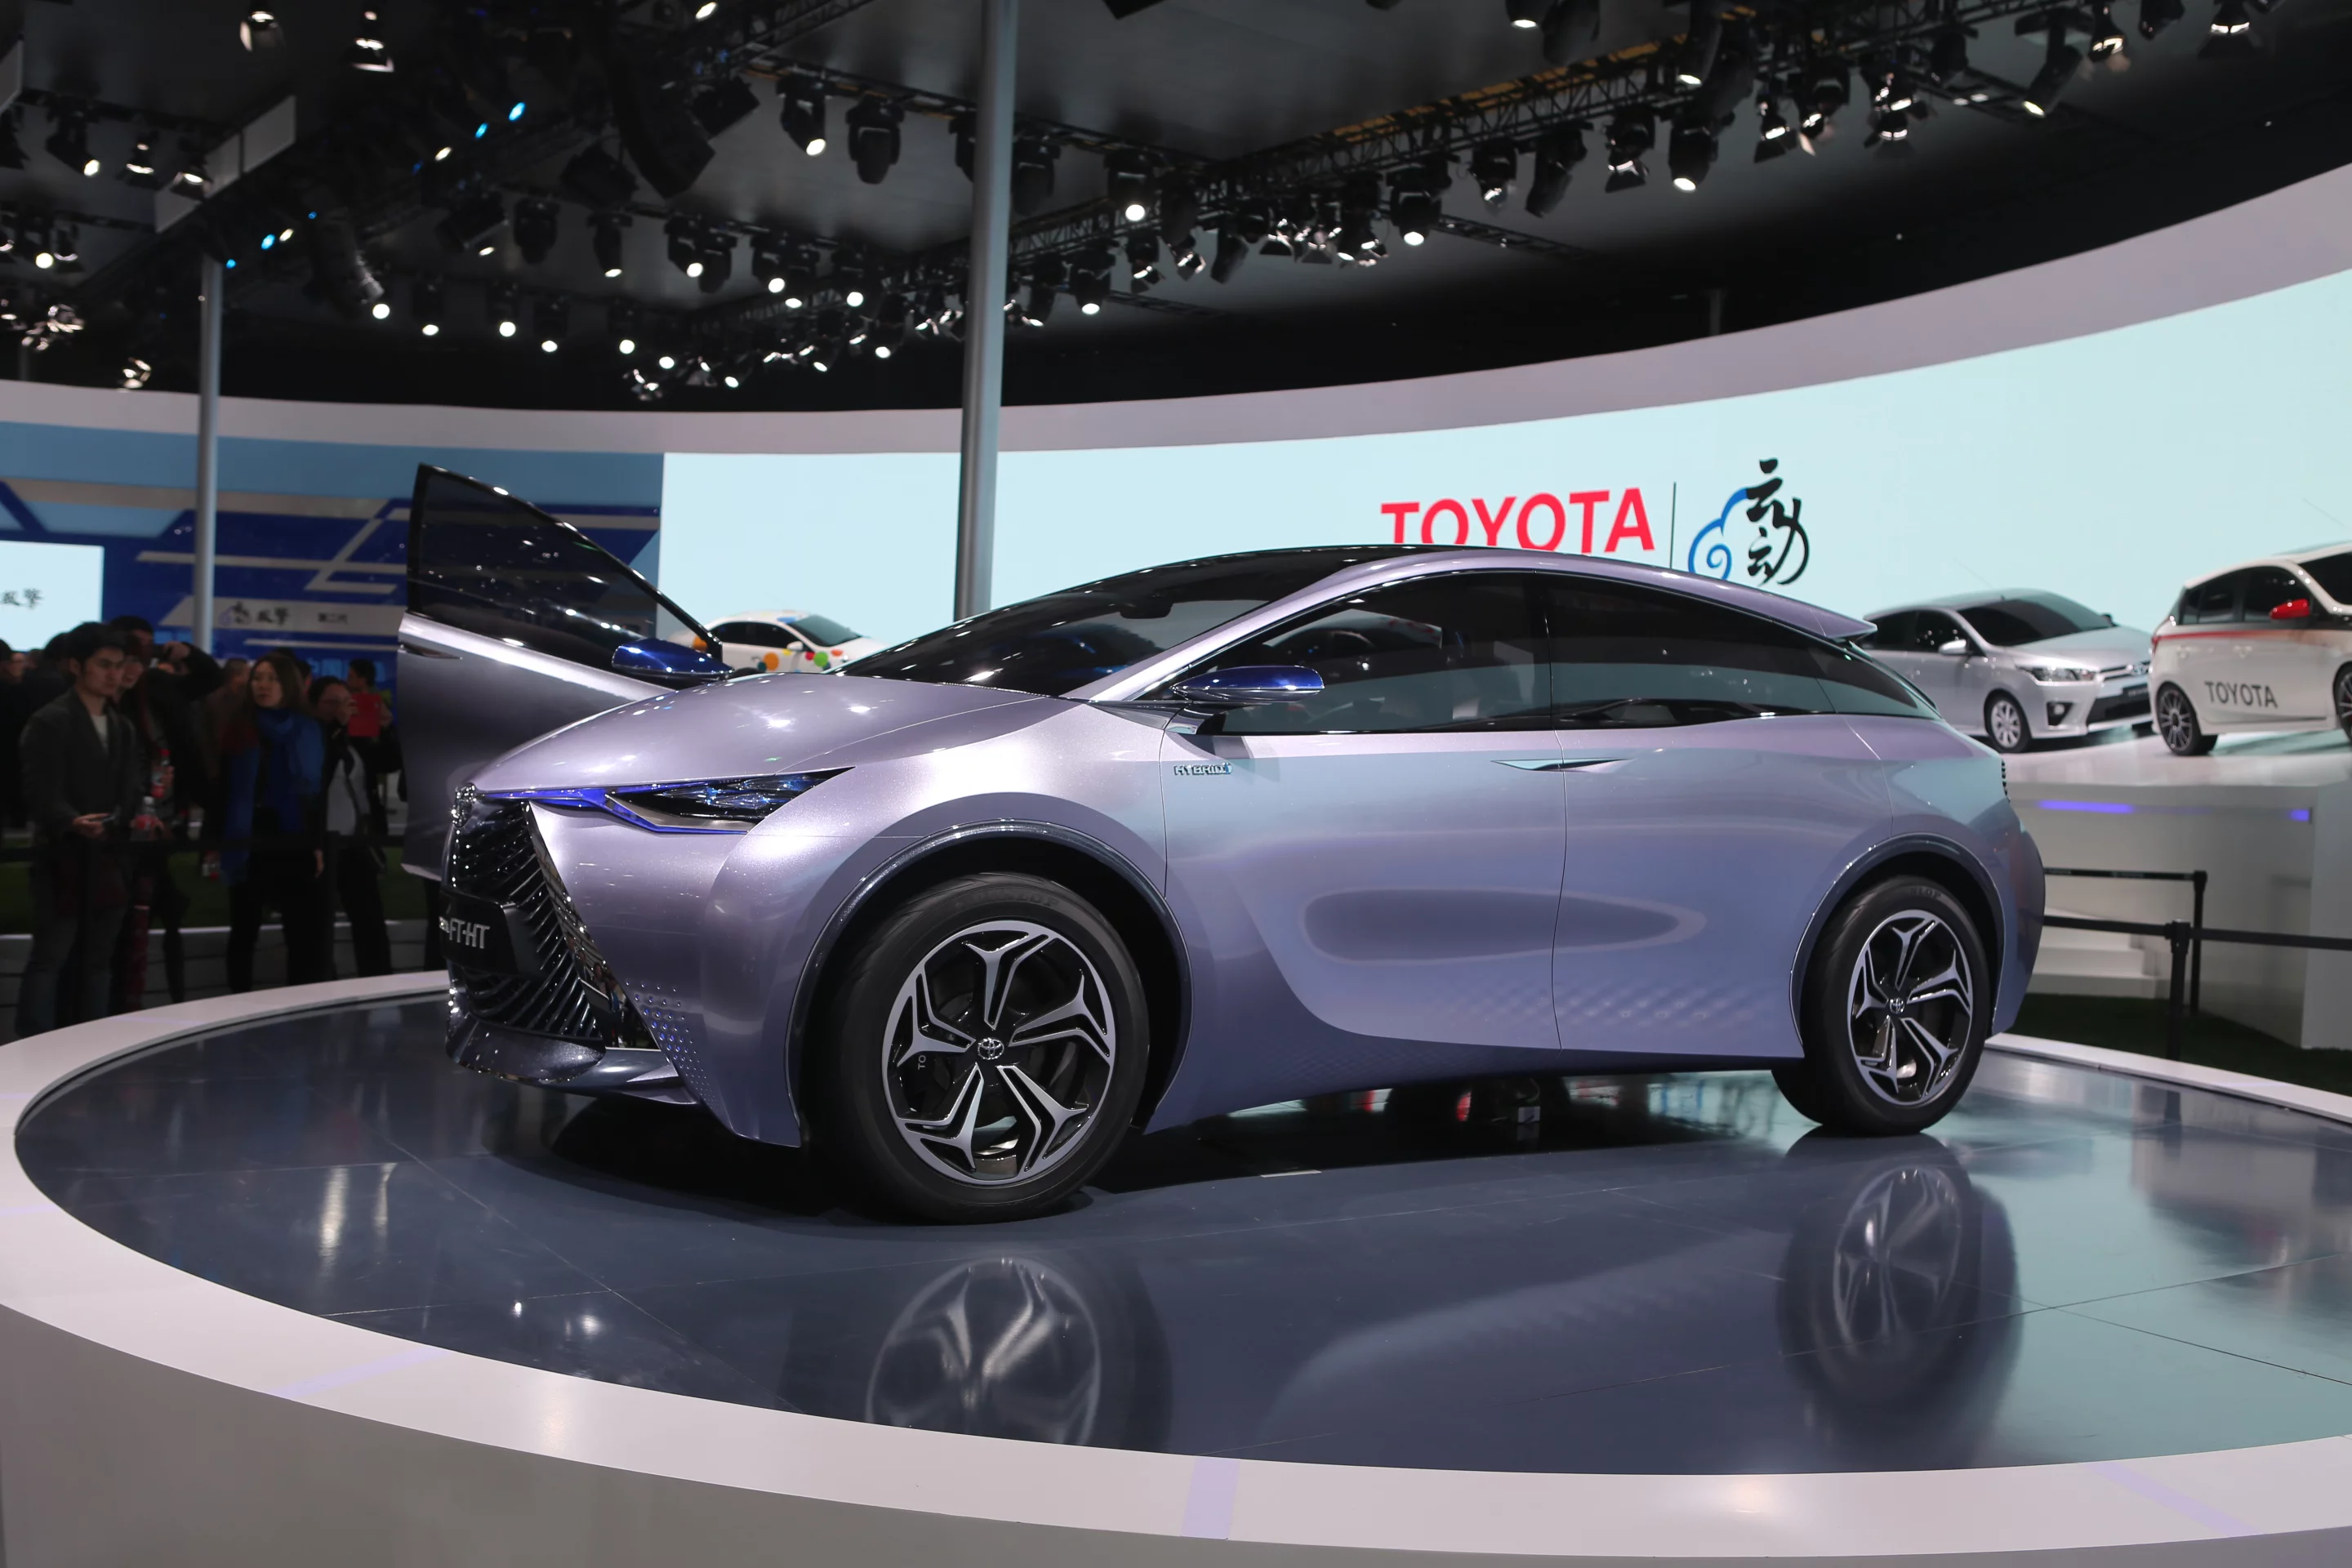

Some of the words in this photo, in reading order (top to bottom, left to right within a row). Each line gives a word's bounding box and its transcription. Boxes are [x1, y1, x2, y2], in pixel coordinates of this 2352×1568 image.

[1380, 488, 1655, 555] TOYOTA
[2204, 681, 2278, 709] TOYOTA
[1174, 764, 1226, 776] HYBRID
